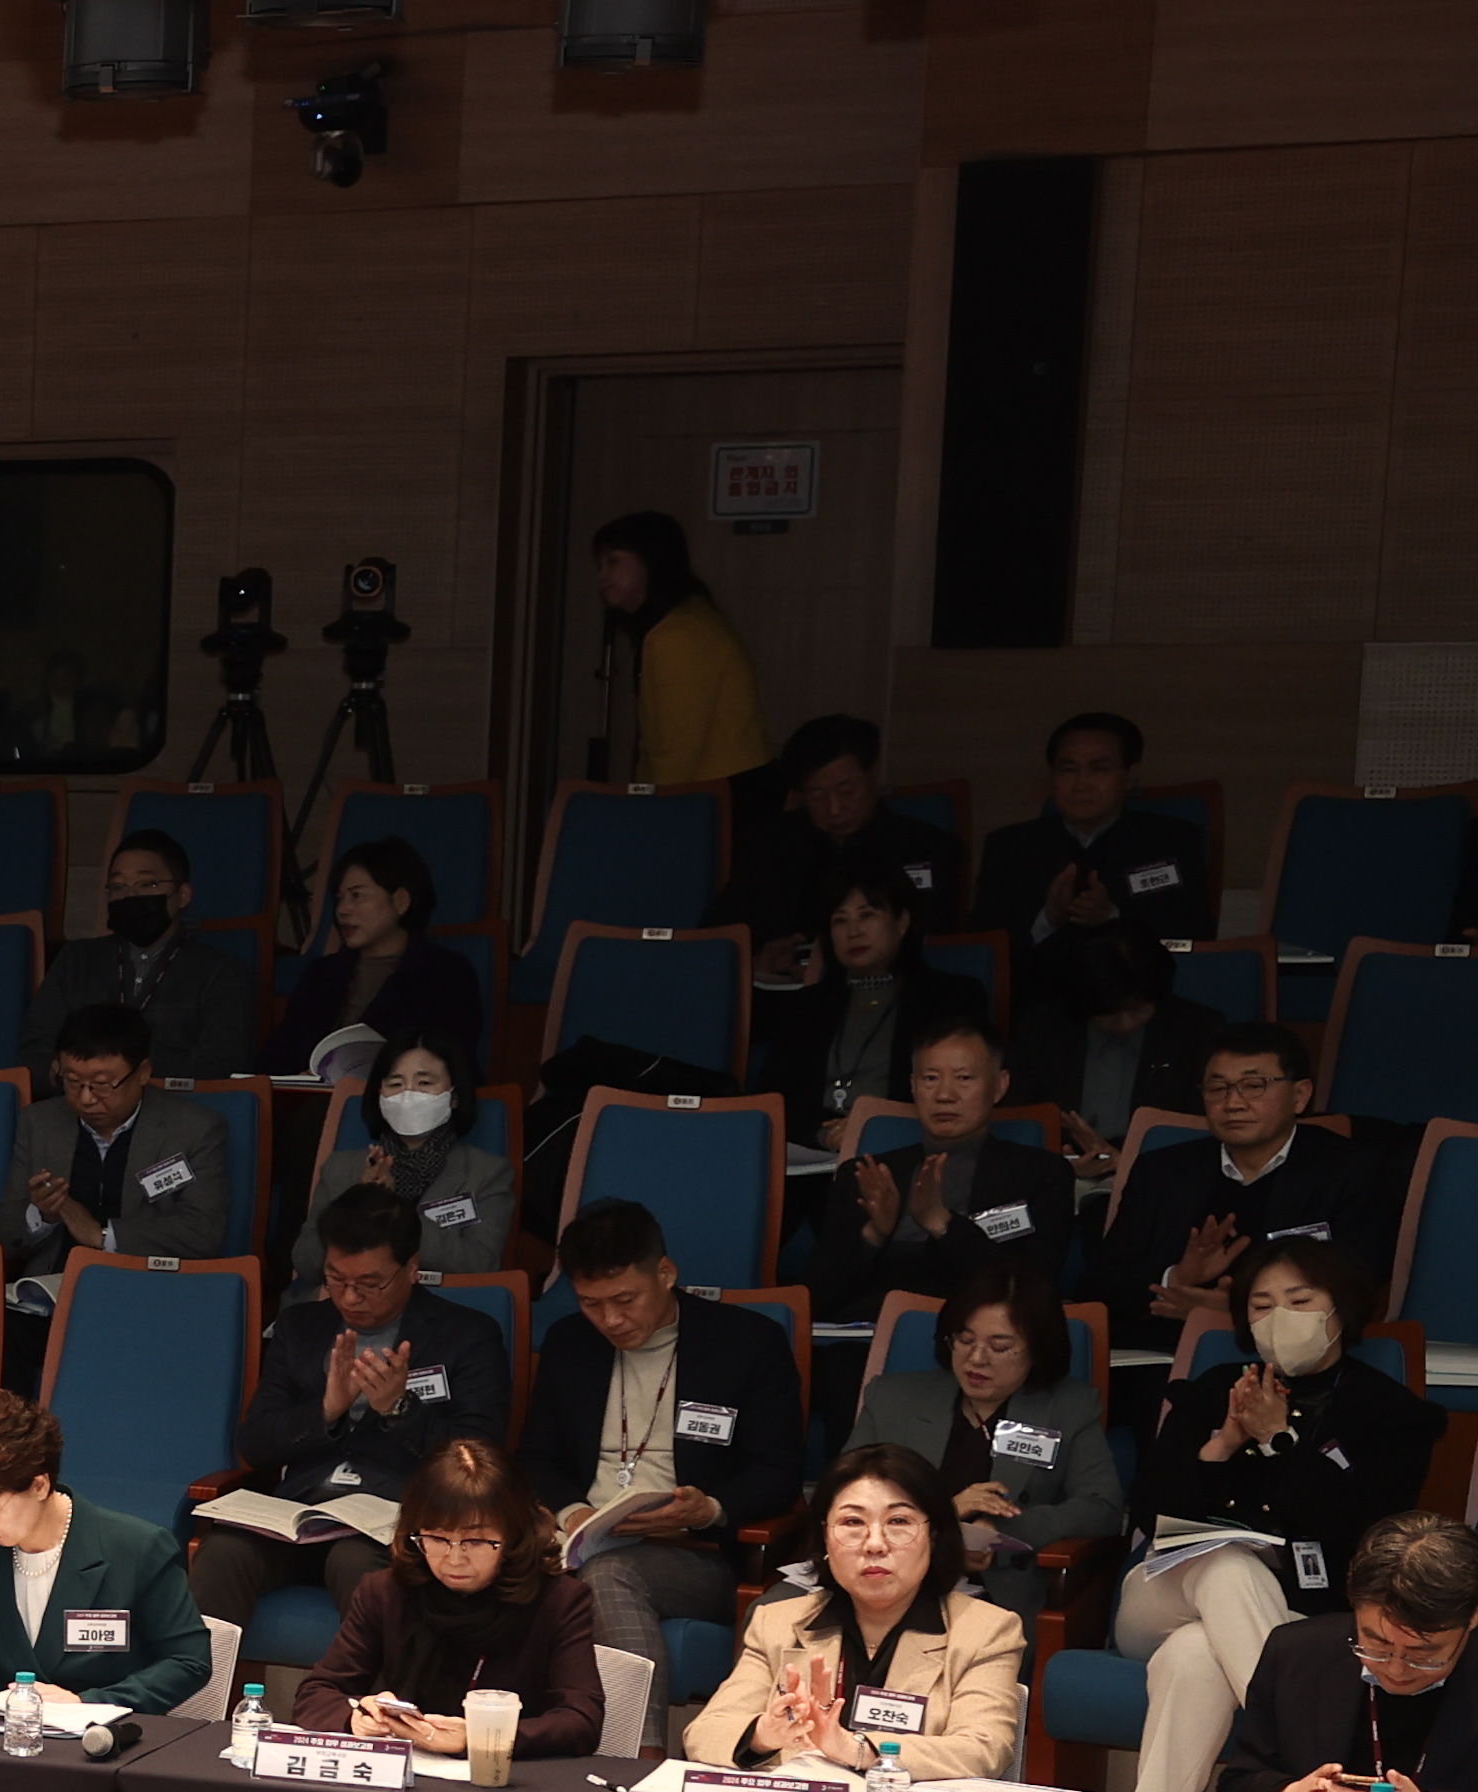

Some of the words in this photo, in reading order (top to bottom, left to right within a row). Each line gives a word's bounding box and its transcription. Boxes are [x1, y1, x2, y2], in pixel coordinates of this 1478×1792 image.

[413, 1384, 436, 1397] 정현
[78, 1629, 116, 1642] 고아영
[867, 1707, 909, 1726] 오찬숙
[286, 1755, 373, 1783] 김금숙
